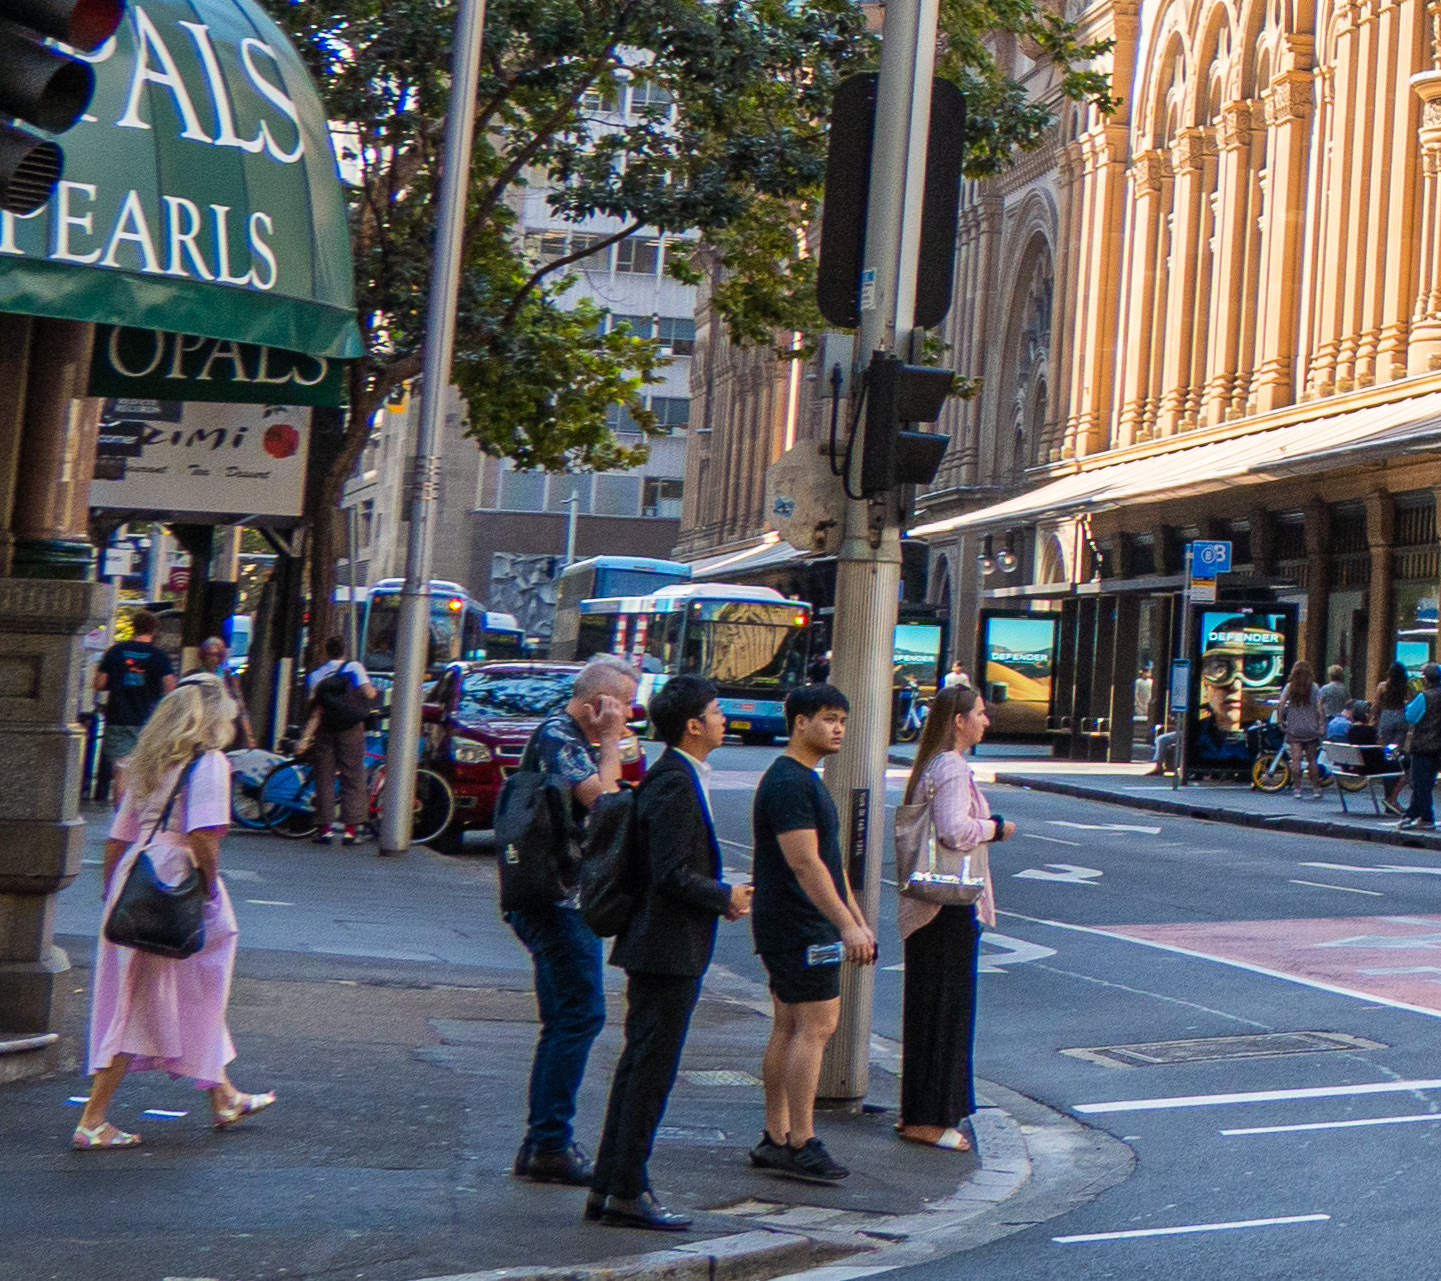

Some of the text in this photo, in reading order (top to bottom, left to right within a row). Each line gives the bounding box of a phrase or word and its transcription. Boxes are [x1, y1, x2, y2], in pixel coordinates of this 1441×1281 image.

[80, 6, 304, 163] ALS
[1208, 631, 1280, 643] DEFENDER
[892, 654, 936, 663] EFENDER
[991, 652, 1048, 663] DEFENDER
